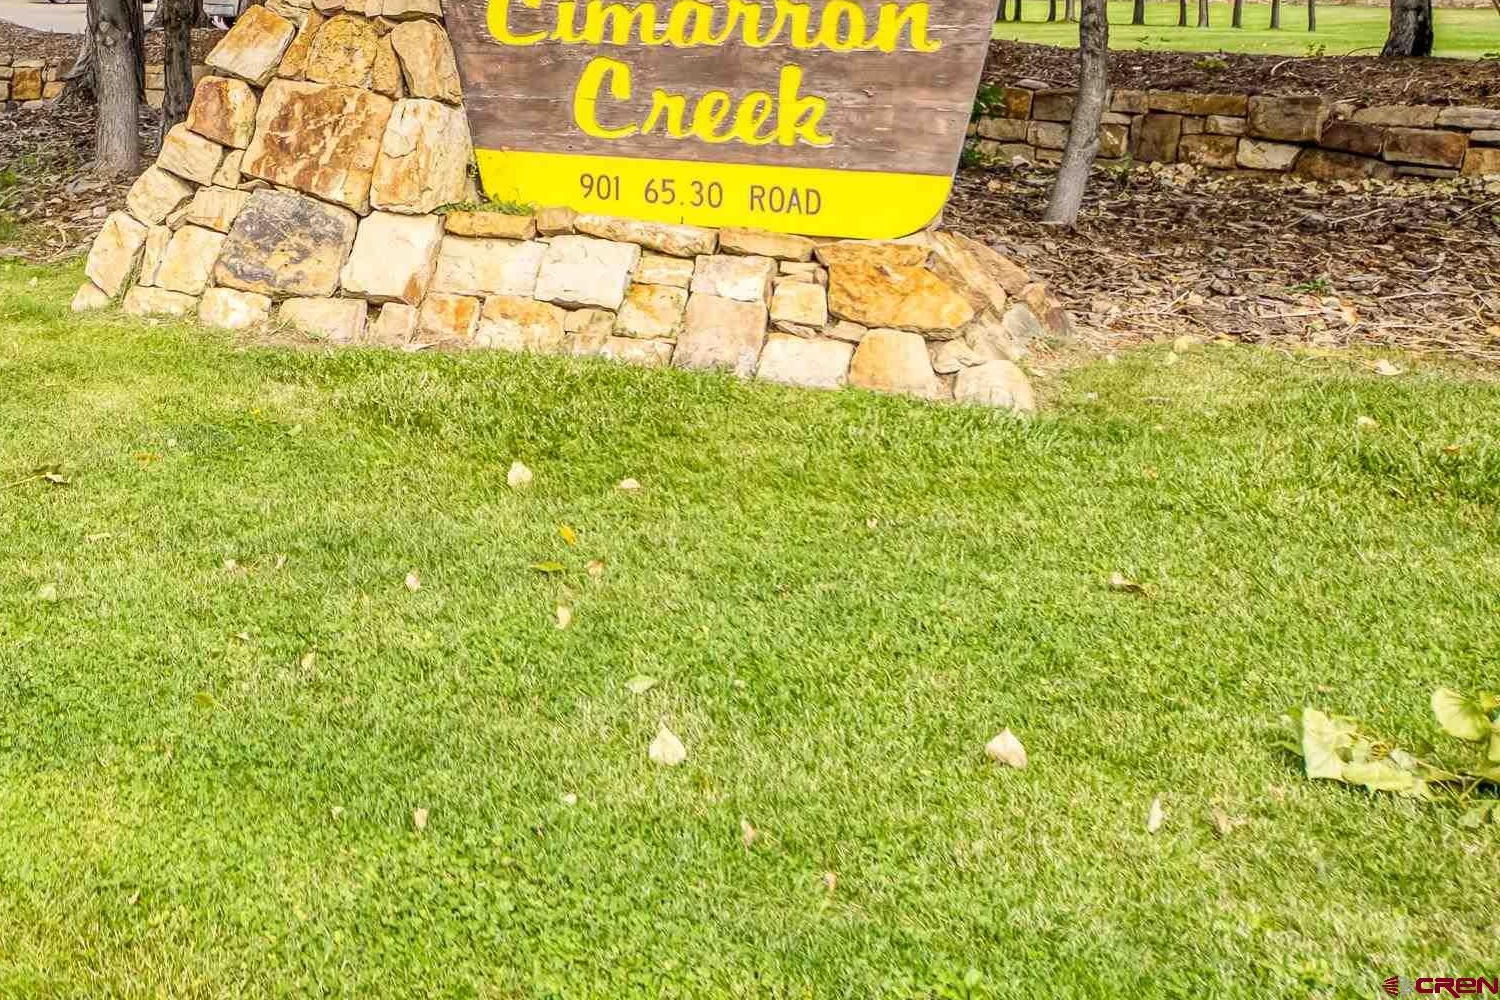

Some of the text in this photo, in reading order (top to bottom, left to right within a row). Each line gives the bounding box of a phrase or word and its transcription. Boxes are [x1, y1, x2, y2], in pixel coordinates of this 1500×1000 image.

[573, 56, 834, 147] Creek
[579, 173, 822, 216] 901 65.30 ROAD
